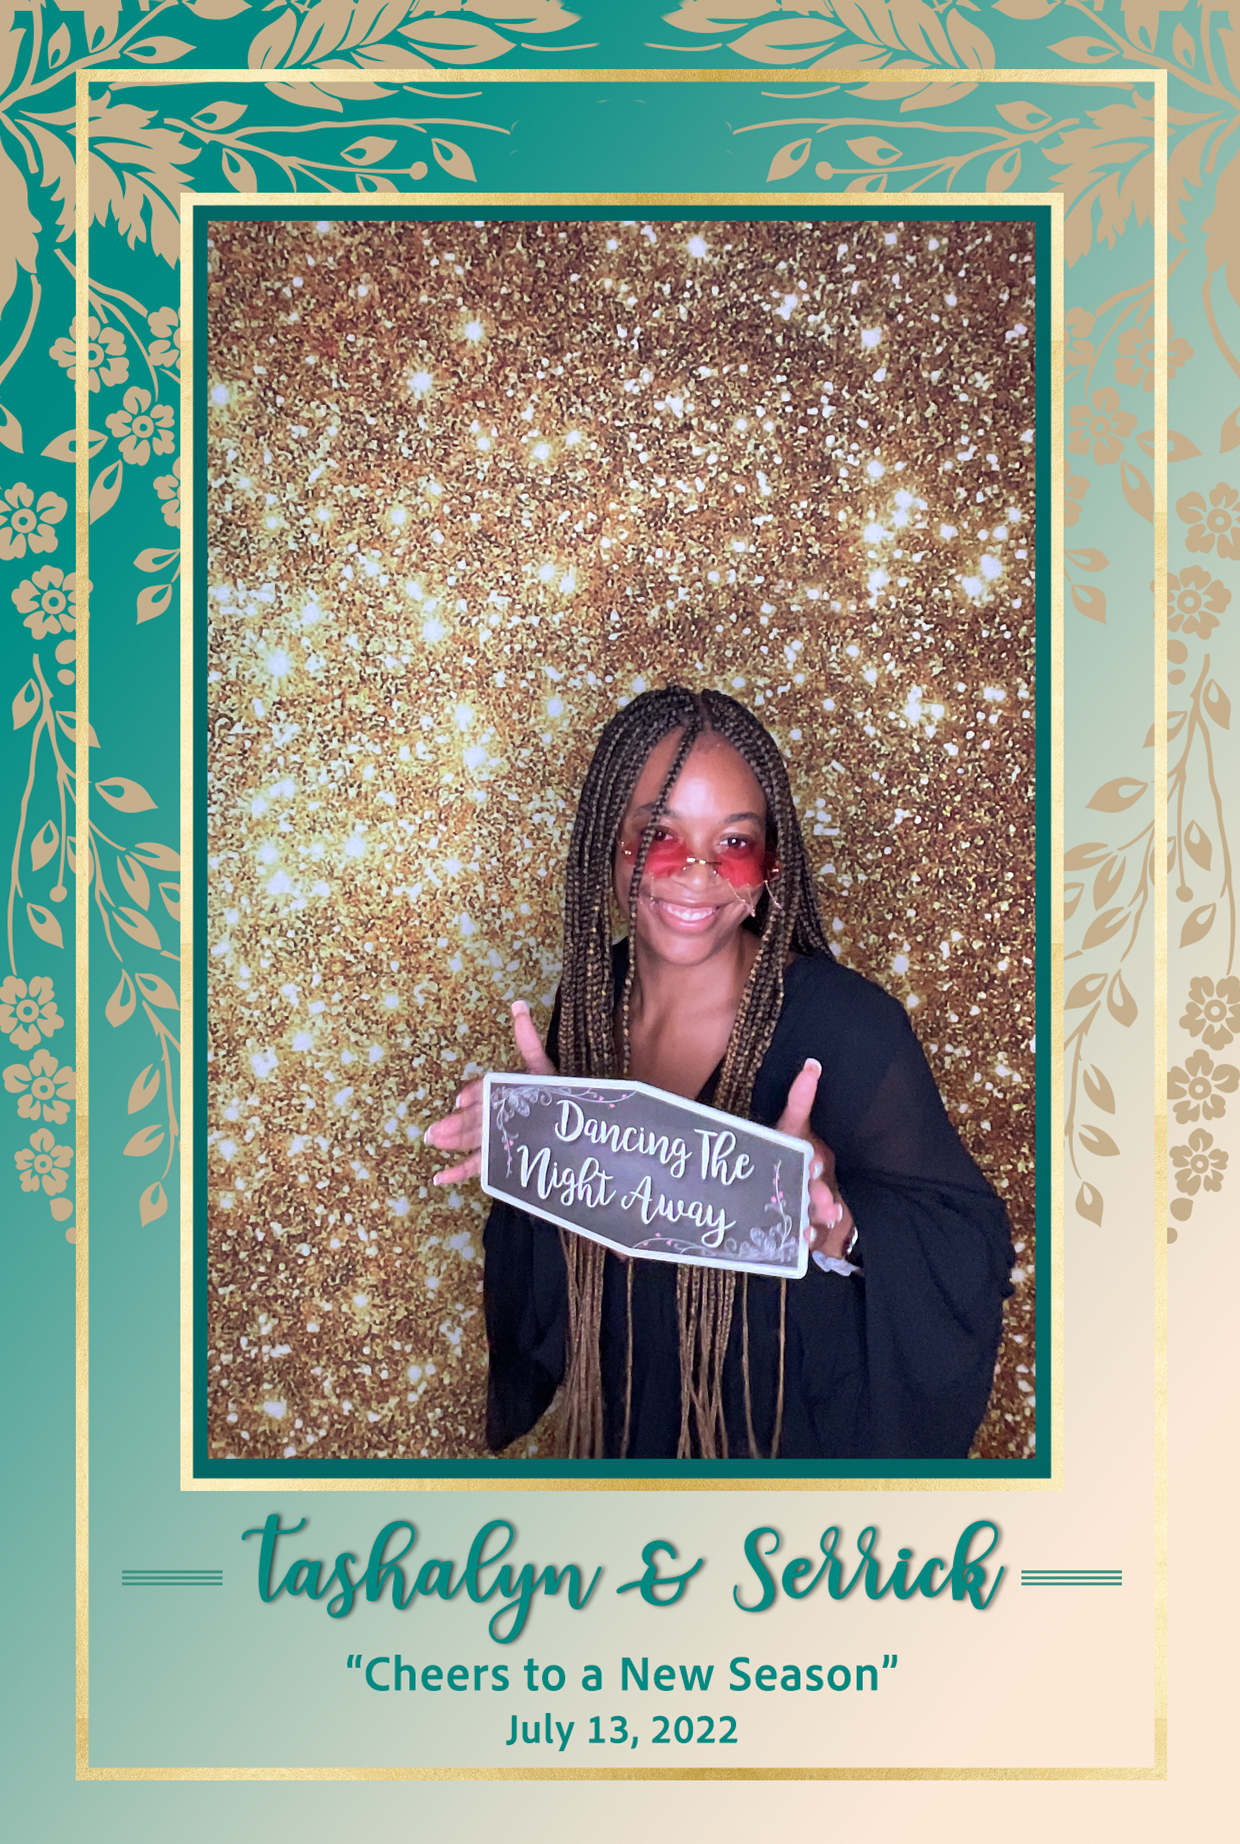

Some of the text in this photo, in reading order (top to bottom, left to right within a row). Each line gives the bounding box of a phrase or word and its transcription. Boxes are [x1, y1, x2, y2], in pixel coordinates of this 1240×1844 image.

[554, 1099, 755, 1186] Dancing The
[516, 1144, 737, 1248] Night Away
